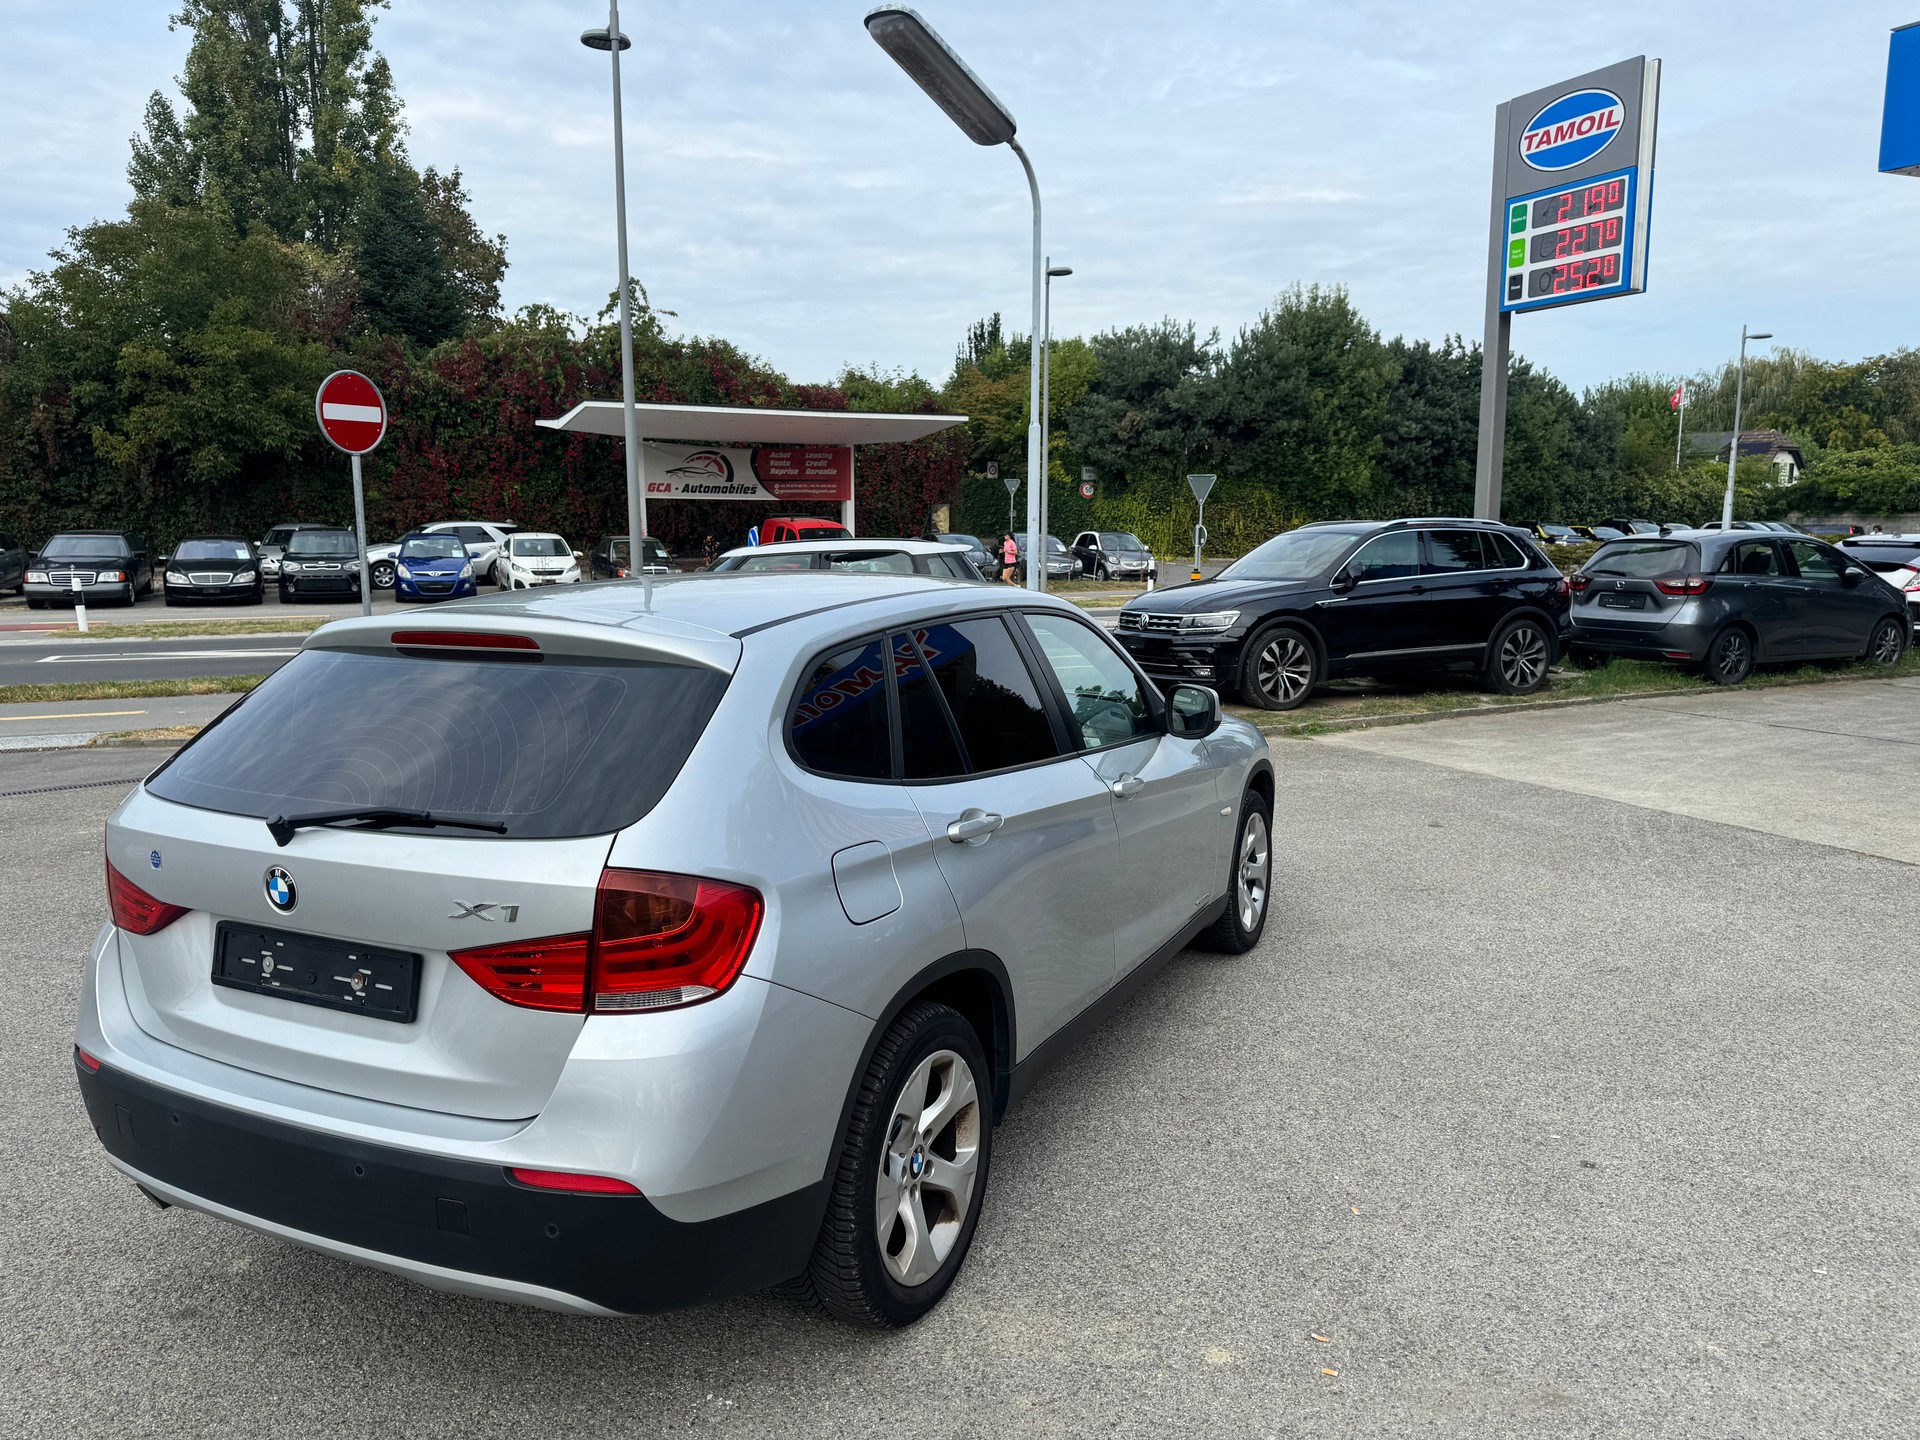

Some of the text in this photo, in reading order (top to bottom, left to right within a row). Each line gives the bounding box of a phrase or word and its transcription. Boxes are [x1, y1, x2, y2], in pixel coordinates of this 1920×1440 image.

[1524, 109, 1621, 152] TAMOIL
[805, 452, 833, 460] Leasing
[770, 468, 799, 476] Reprise
[805, 467, 837, 475] Garantie
[647, 482, 672, 493] GCA
[681, 483, 758, 495] Automobiles
[447, 899, 520, 922] X1
